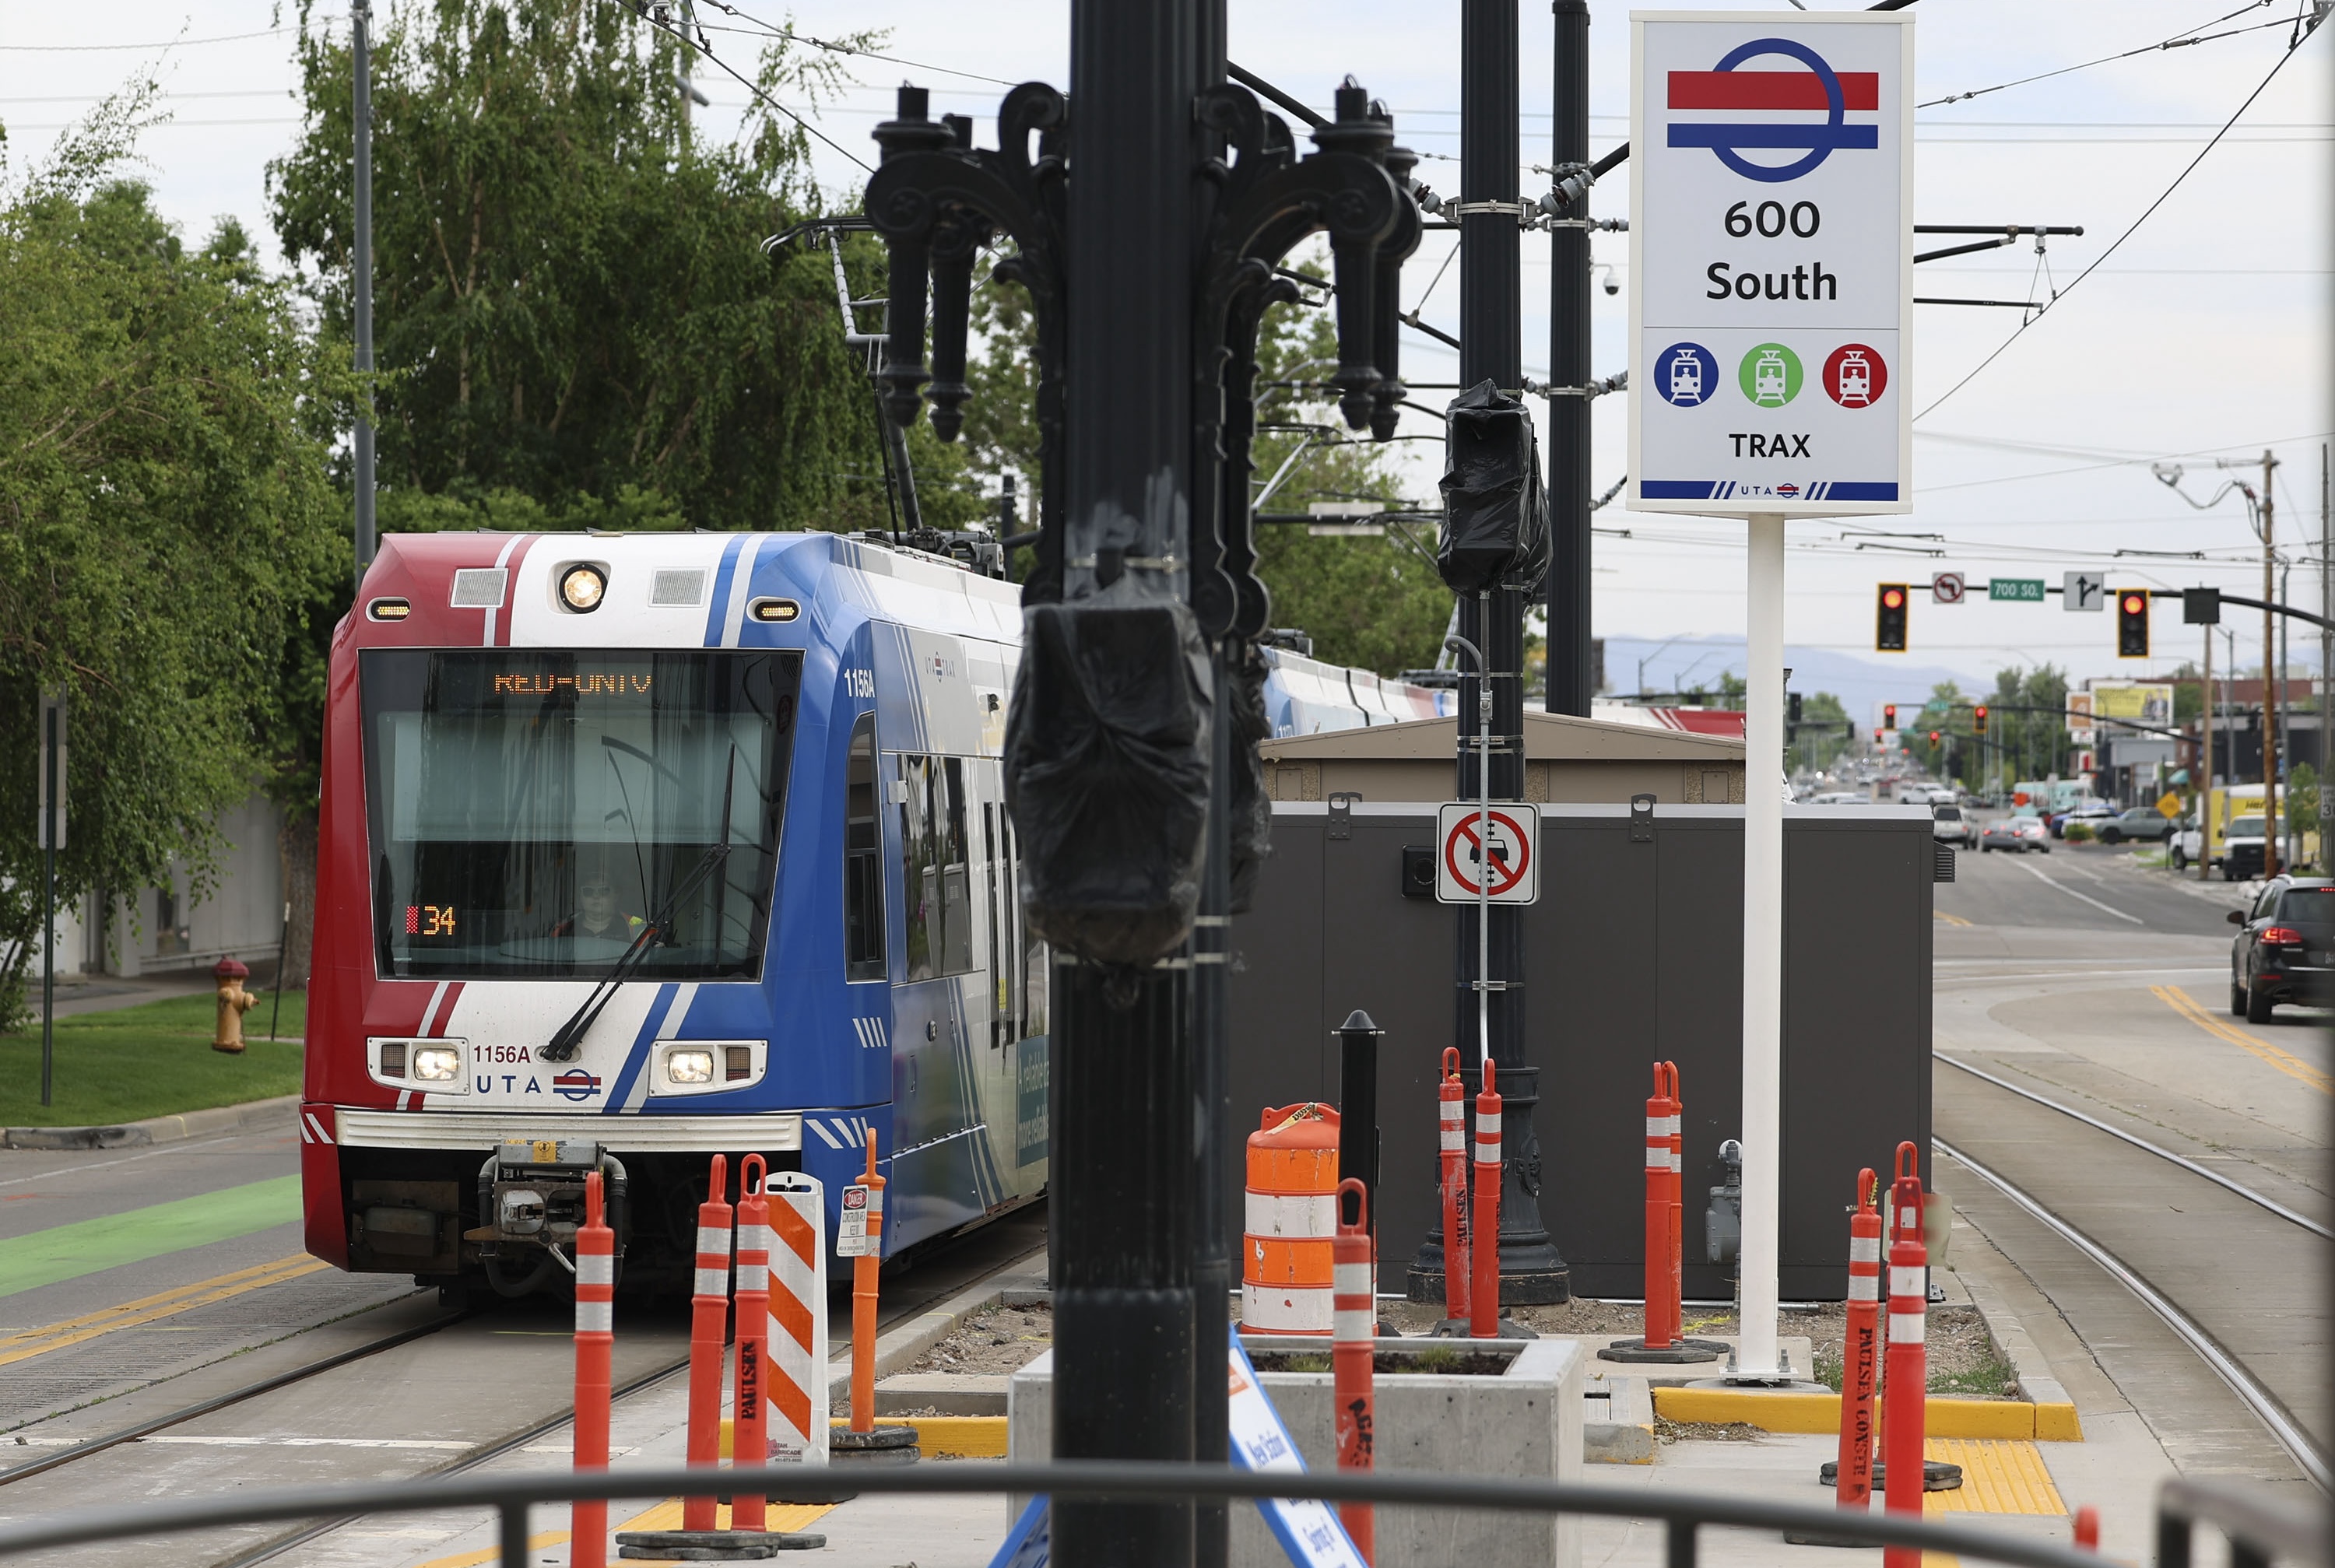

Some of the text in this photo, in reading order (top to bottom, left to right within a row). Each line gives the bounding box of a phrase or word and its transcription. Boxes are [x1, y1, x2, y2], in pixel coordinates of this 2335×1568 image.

[1724, 200, 1821, 238] 600
[1706, 261, 1837, 301] South
[1729, 433, 1811, 458] TRAX
[1741, 486, 1772, 496] UTA
[1994, 582, 2017, 598] 700
[844, 668, 876, 698] 1156A
[423, 906, 456, 935] 34
[474, 1045, 531, 1063] 1156A
[476, 1075, 542, 1093] UTA
[1856, 1328, 1873, 1401] PAULSEN
[741, 1341, 757, 1420] PAULSEN
